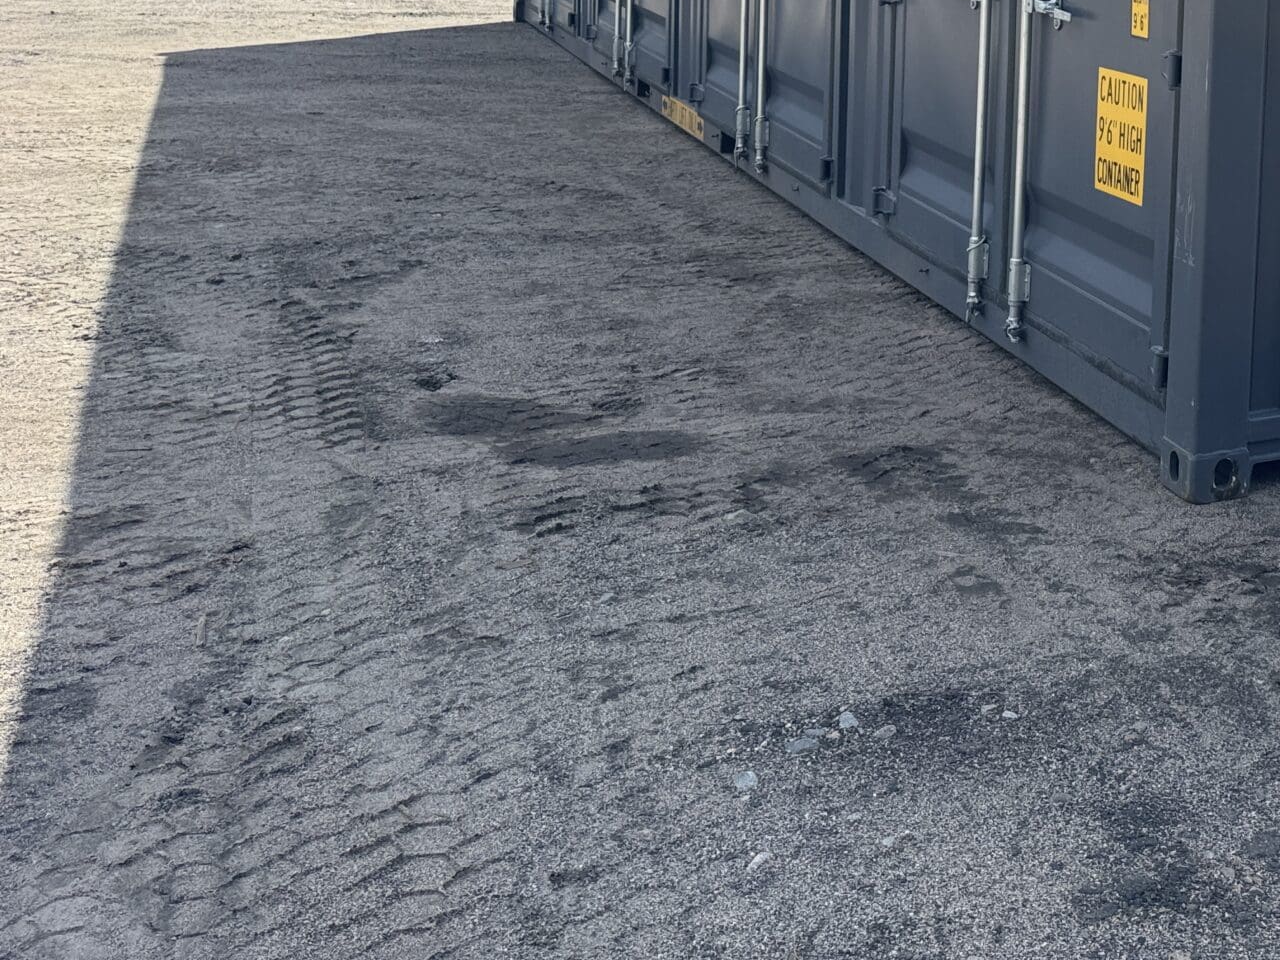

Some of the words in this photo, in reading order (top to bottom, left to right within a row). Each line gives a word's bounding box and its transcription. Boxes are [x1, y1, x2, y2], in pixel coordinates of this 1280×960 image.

[1100, 75, 1144, 113] CAUTION
[1099, 116, 1117, 145] 9'6"
[1118, 121, 1143, 155] HIGH
[1097, 157, 1141, 198] CONTAINER
